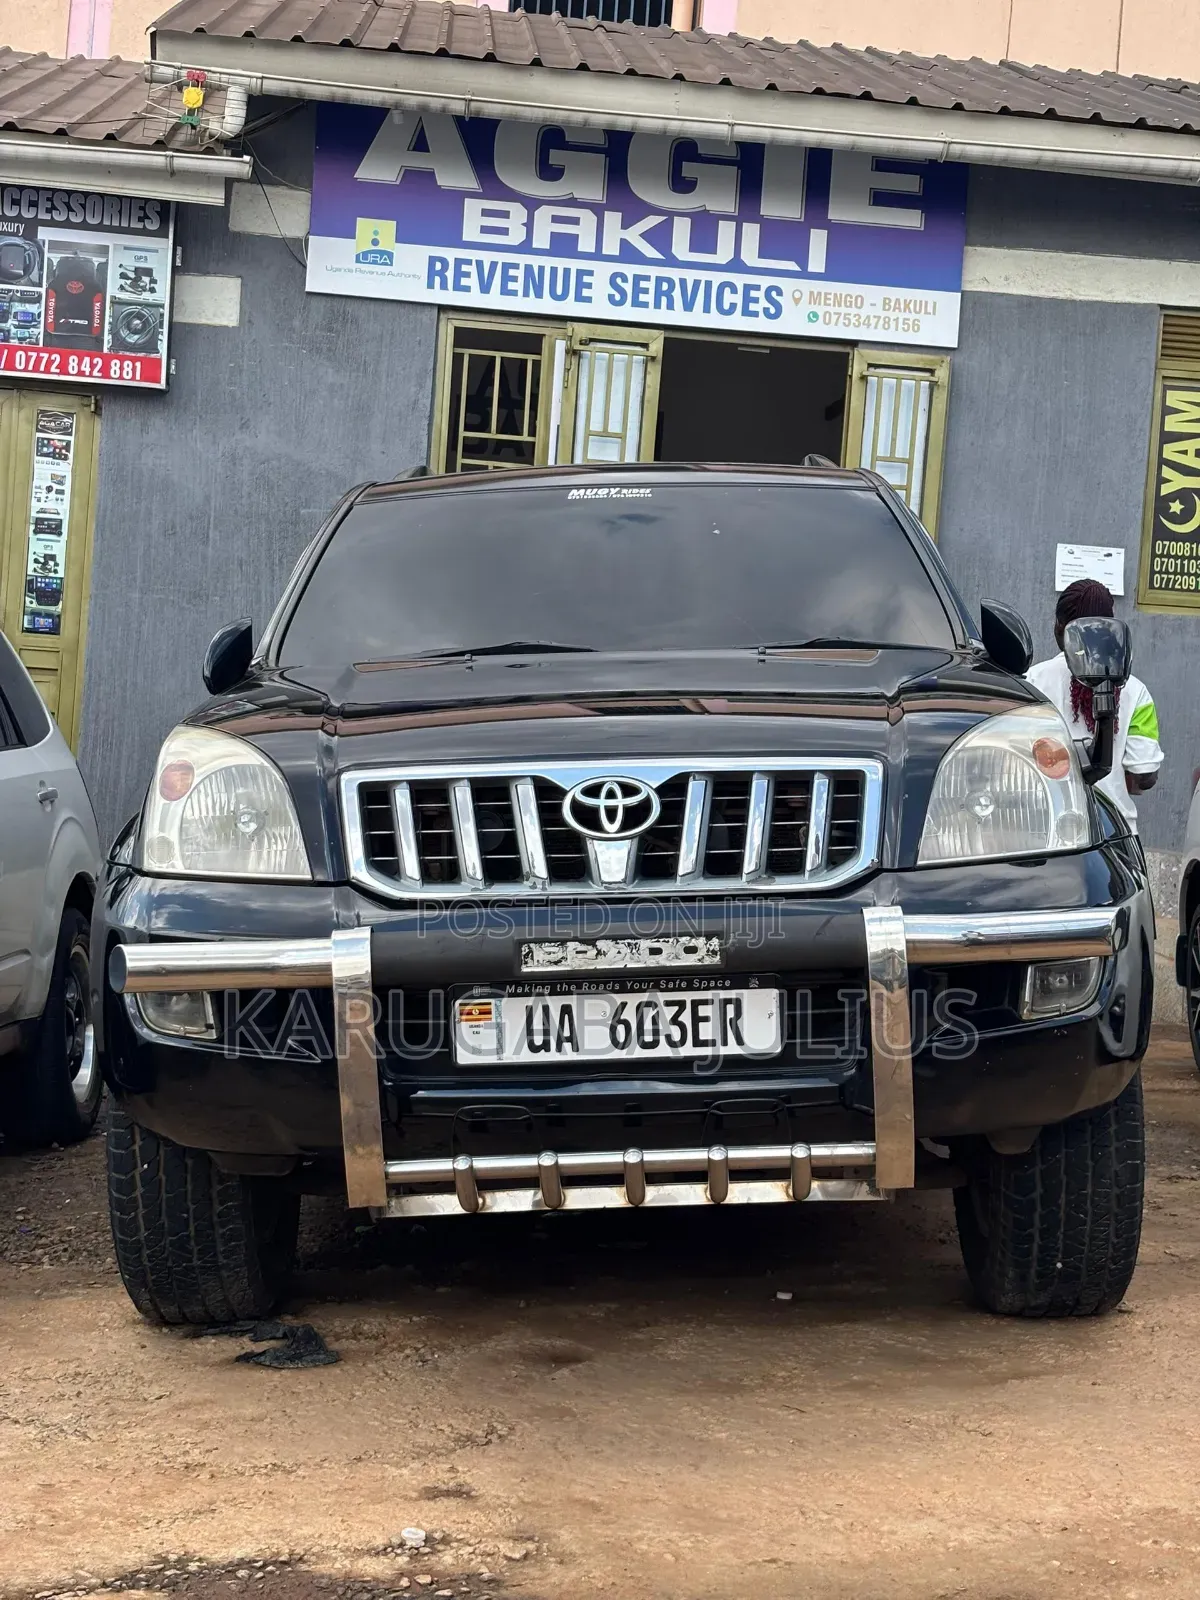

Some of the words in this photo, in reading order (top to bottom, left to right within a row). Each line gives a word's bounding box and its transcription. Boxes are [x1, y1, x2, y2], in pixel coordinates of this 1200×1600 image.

[354, 107, 925, 231] AGGIE
[0, 185, 161, 231] CCESSORIES
[462, 197, 828, 273] BAKULI
[325, 264, 354, 273] Uganda
[360, 252, 391, 265] URA
[426, 254, 593, 305] REVENUE
[607, 270, 785, 321] SERVICES
[47, 298, 56, 323] TOYOTA
[93, 302, 102, 327] TOYOTA
[808, 290, 865, 310] MENGO
[882, 296, 937, 316] BAKULI
[822, 310, 921, 333] 0753478156
[15, 350, 61, 373] 0772
[68, 355, 103, 376] 842
[110, 359, 142, 380] 881
[505, 983, 551, 994] Making
[556, 982, 577, 992] the
[582, 981, 620, 991] Roads
[626, 980, 655, 990] Your
[659, 979, 688, 989] Safe
[693, 978, 731, 989] Space
[525, 1003, 579, 1053] UA
[609, 997, 745, 1050] 603ER
